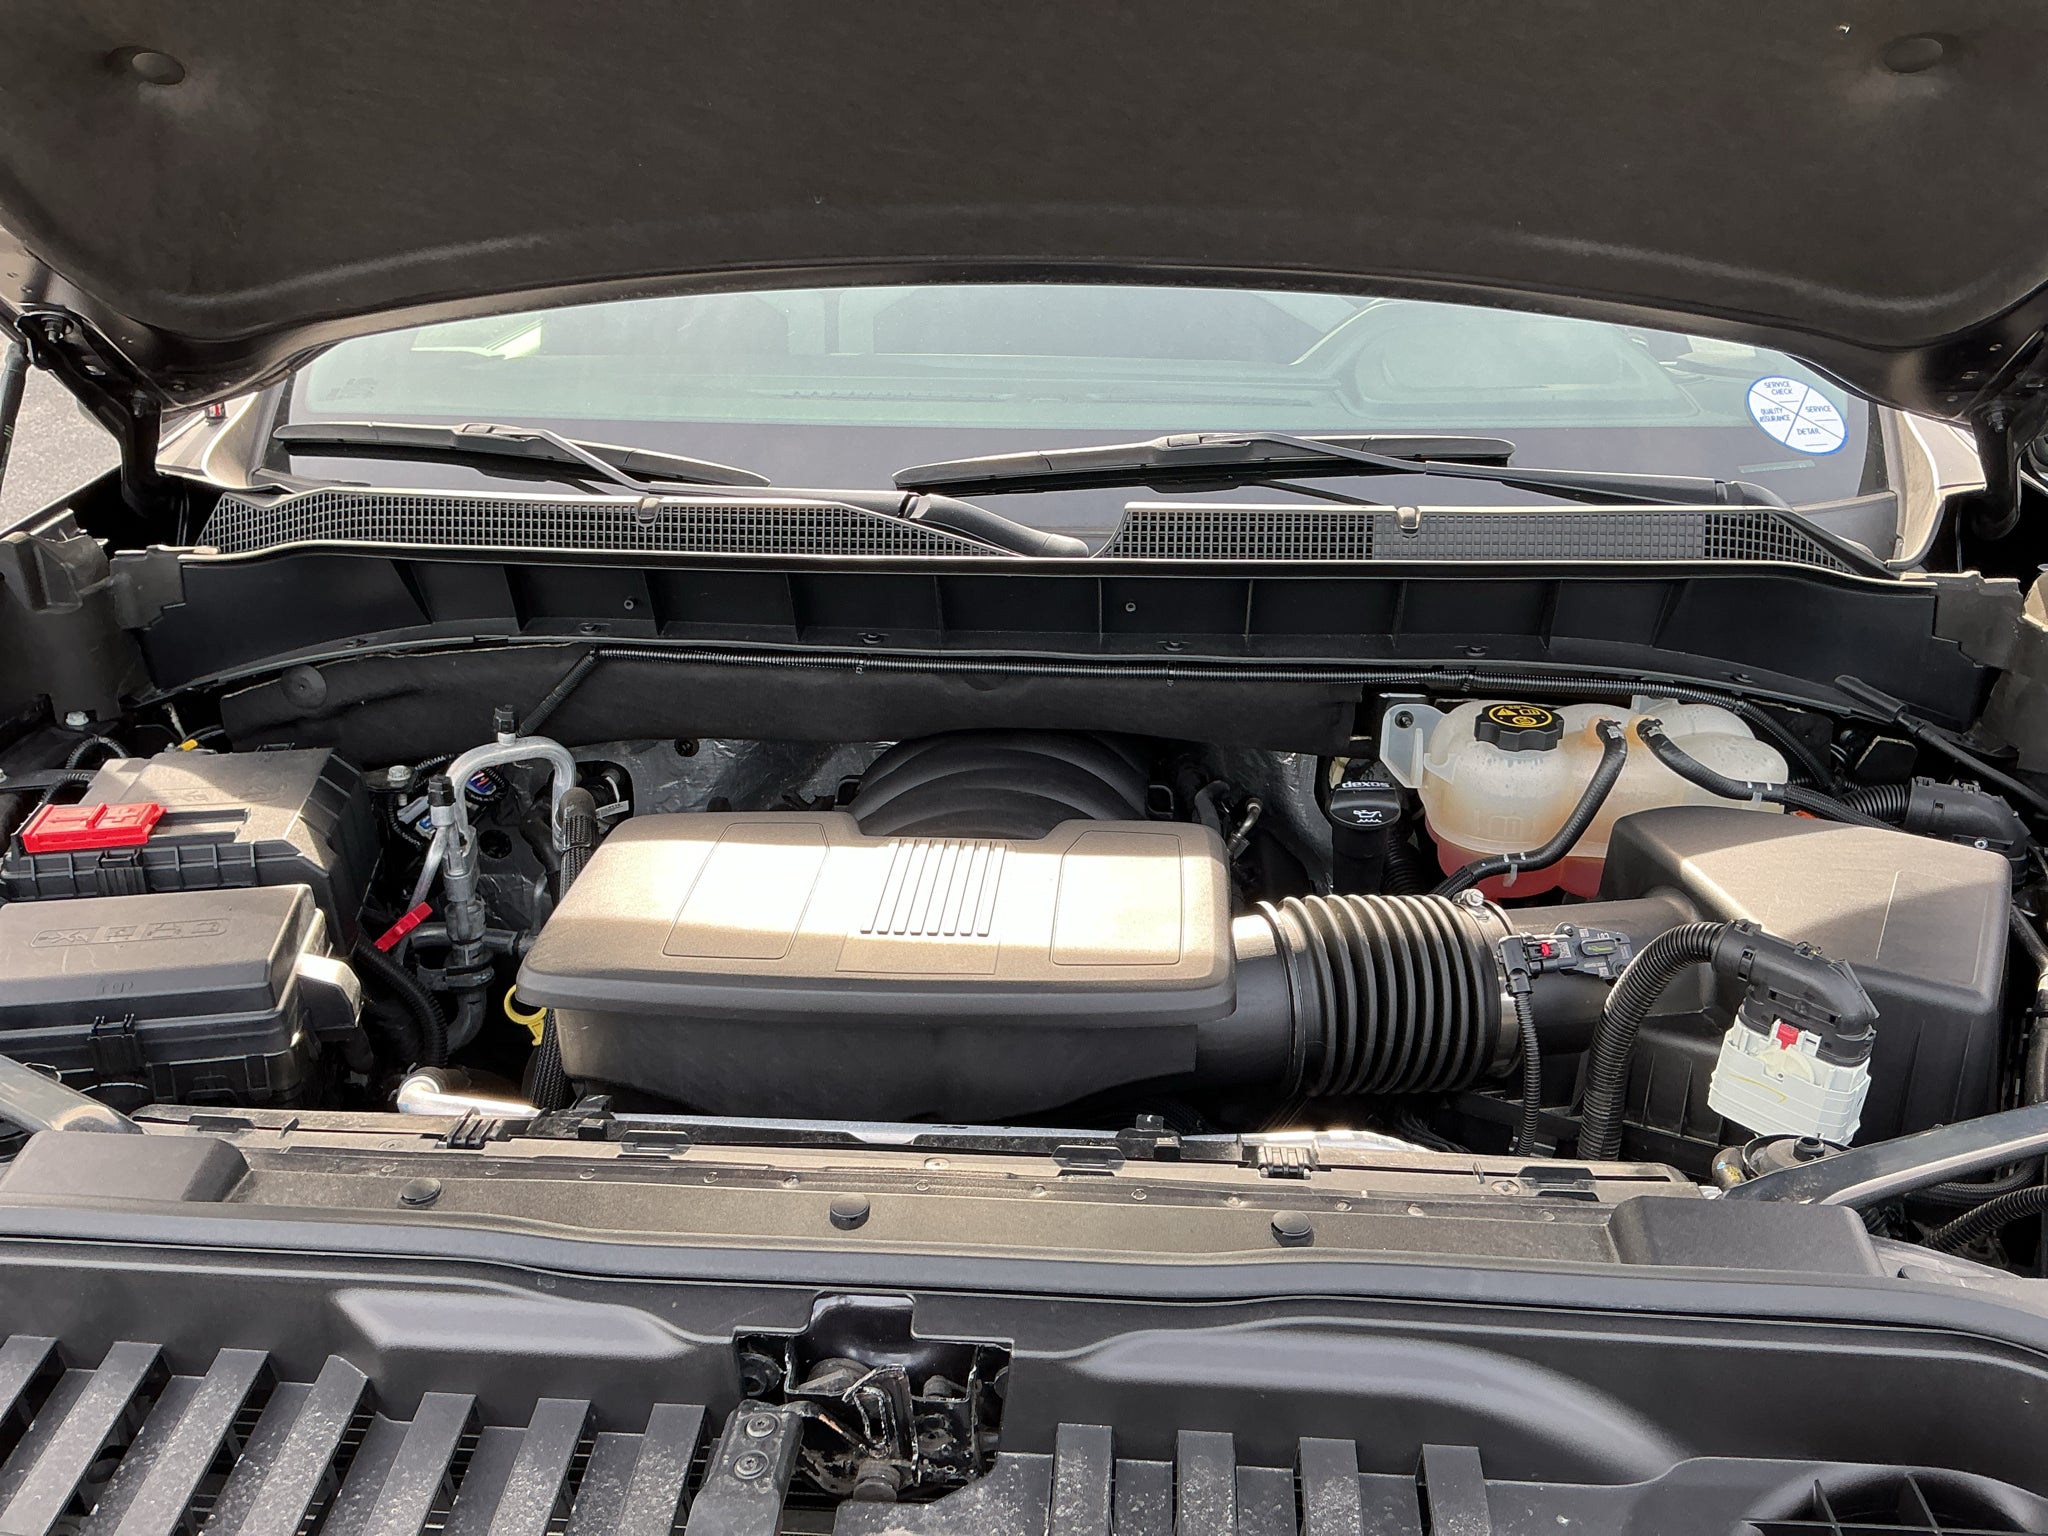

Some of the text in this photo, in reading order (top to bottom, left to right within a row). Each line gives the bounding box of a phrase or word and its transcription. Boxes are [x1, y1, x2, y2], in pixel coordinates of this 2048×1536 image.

[1764, 381, 1791, 389] SERVICE
[1760, 407, 1783, 415] QUALITY
[1805, 405, 1832, 413] SERVICE
[1796, 428, 1821, 436] DETAIL
